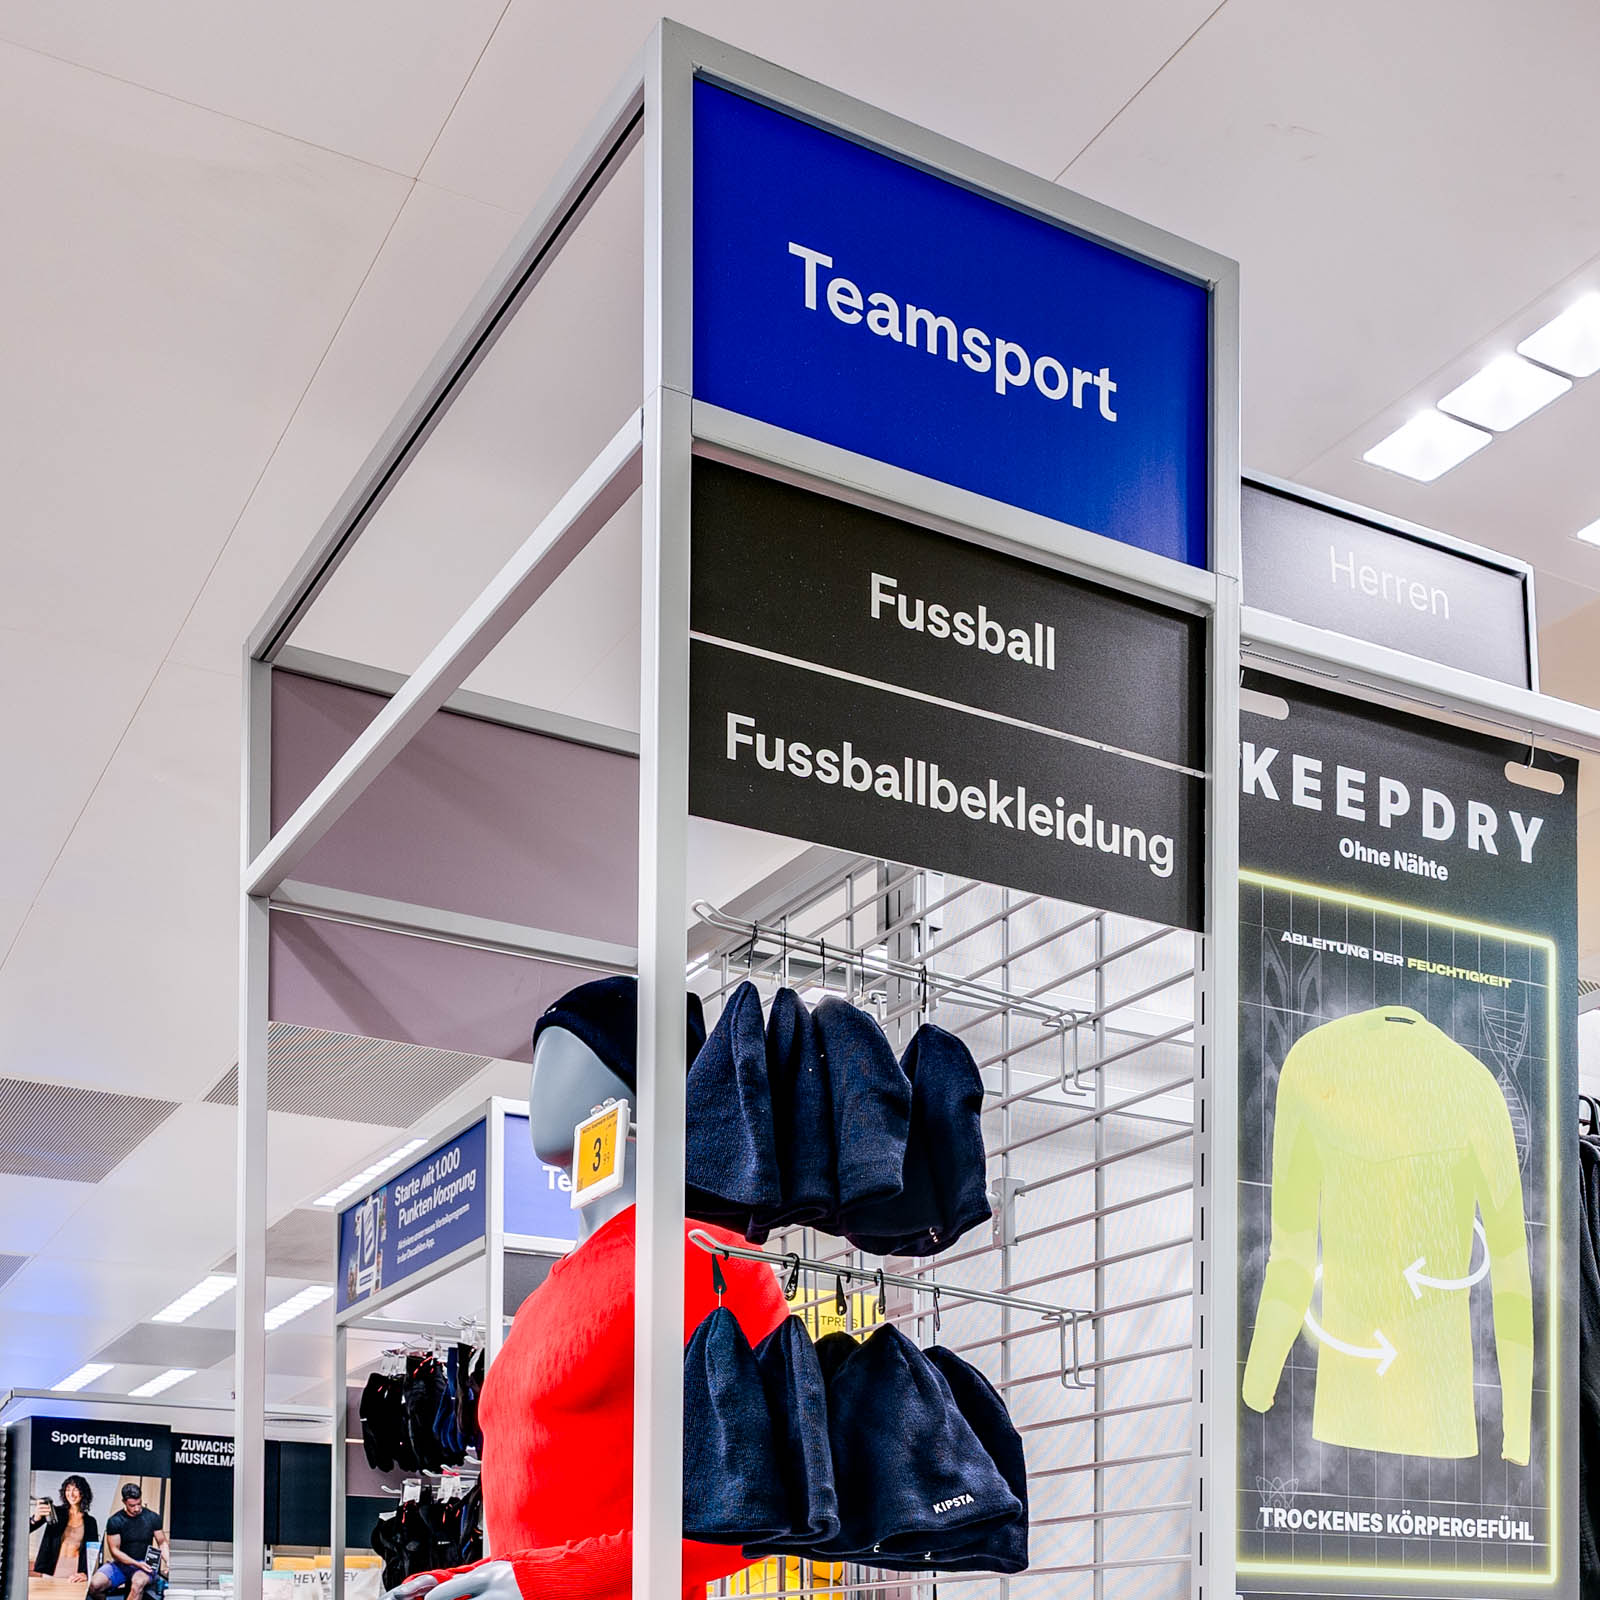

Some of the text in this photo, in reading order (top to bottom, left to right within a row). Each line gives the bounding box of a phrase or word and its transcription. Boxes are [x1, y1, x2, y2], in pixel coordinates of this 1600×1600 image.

[788, 241, 1117, 422] Teamsport
[1328, 544, 1450, 620] Herren
[869, 572, 1056, 672] Fussball
[726, 711, 1174, 878] Fussballbekleidung
[1241, 741, 1544, 864] KEEPDRY
[1339, 837, 1449, 882] Ohne Nähte
[1281, 930, 1512, 989] ABLEITUNG DER FEUCHTIGKEIT
[394, 1177, 420, 1206] Starte
[435, 1147, 460, 1182] 1.000
[592, 1137, 602, 1172] 3
[398, 1168, 476, 1229] Punkten Vorsprung
[51, 1430, 153, 1451] Sporternährung
[79, 1447, 126, 1461] Fitness
[181, 1439, 234, 1454] ZUWACHS
[932, 1492, 975, 1515] KIPSTA
[1260, 1506, 1535, 1542] TROCKENES KÖRPERGEFÜHL
